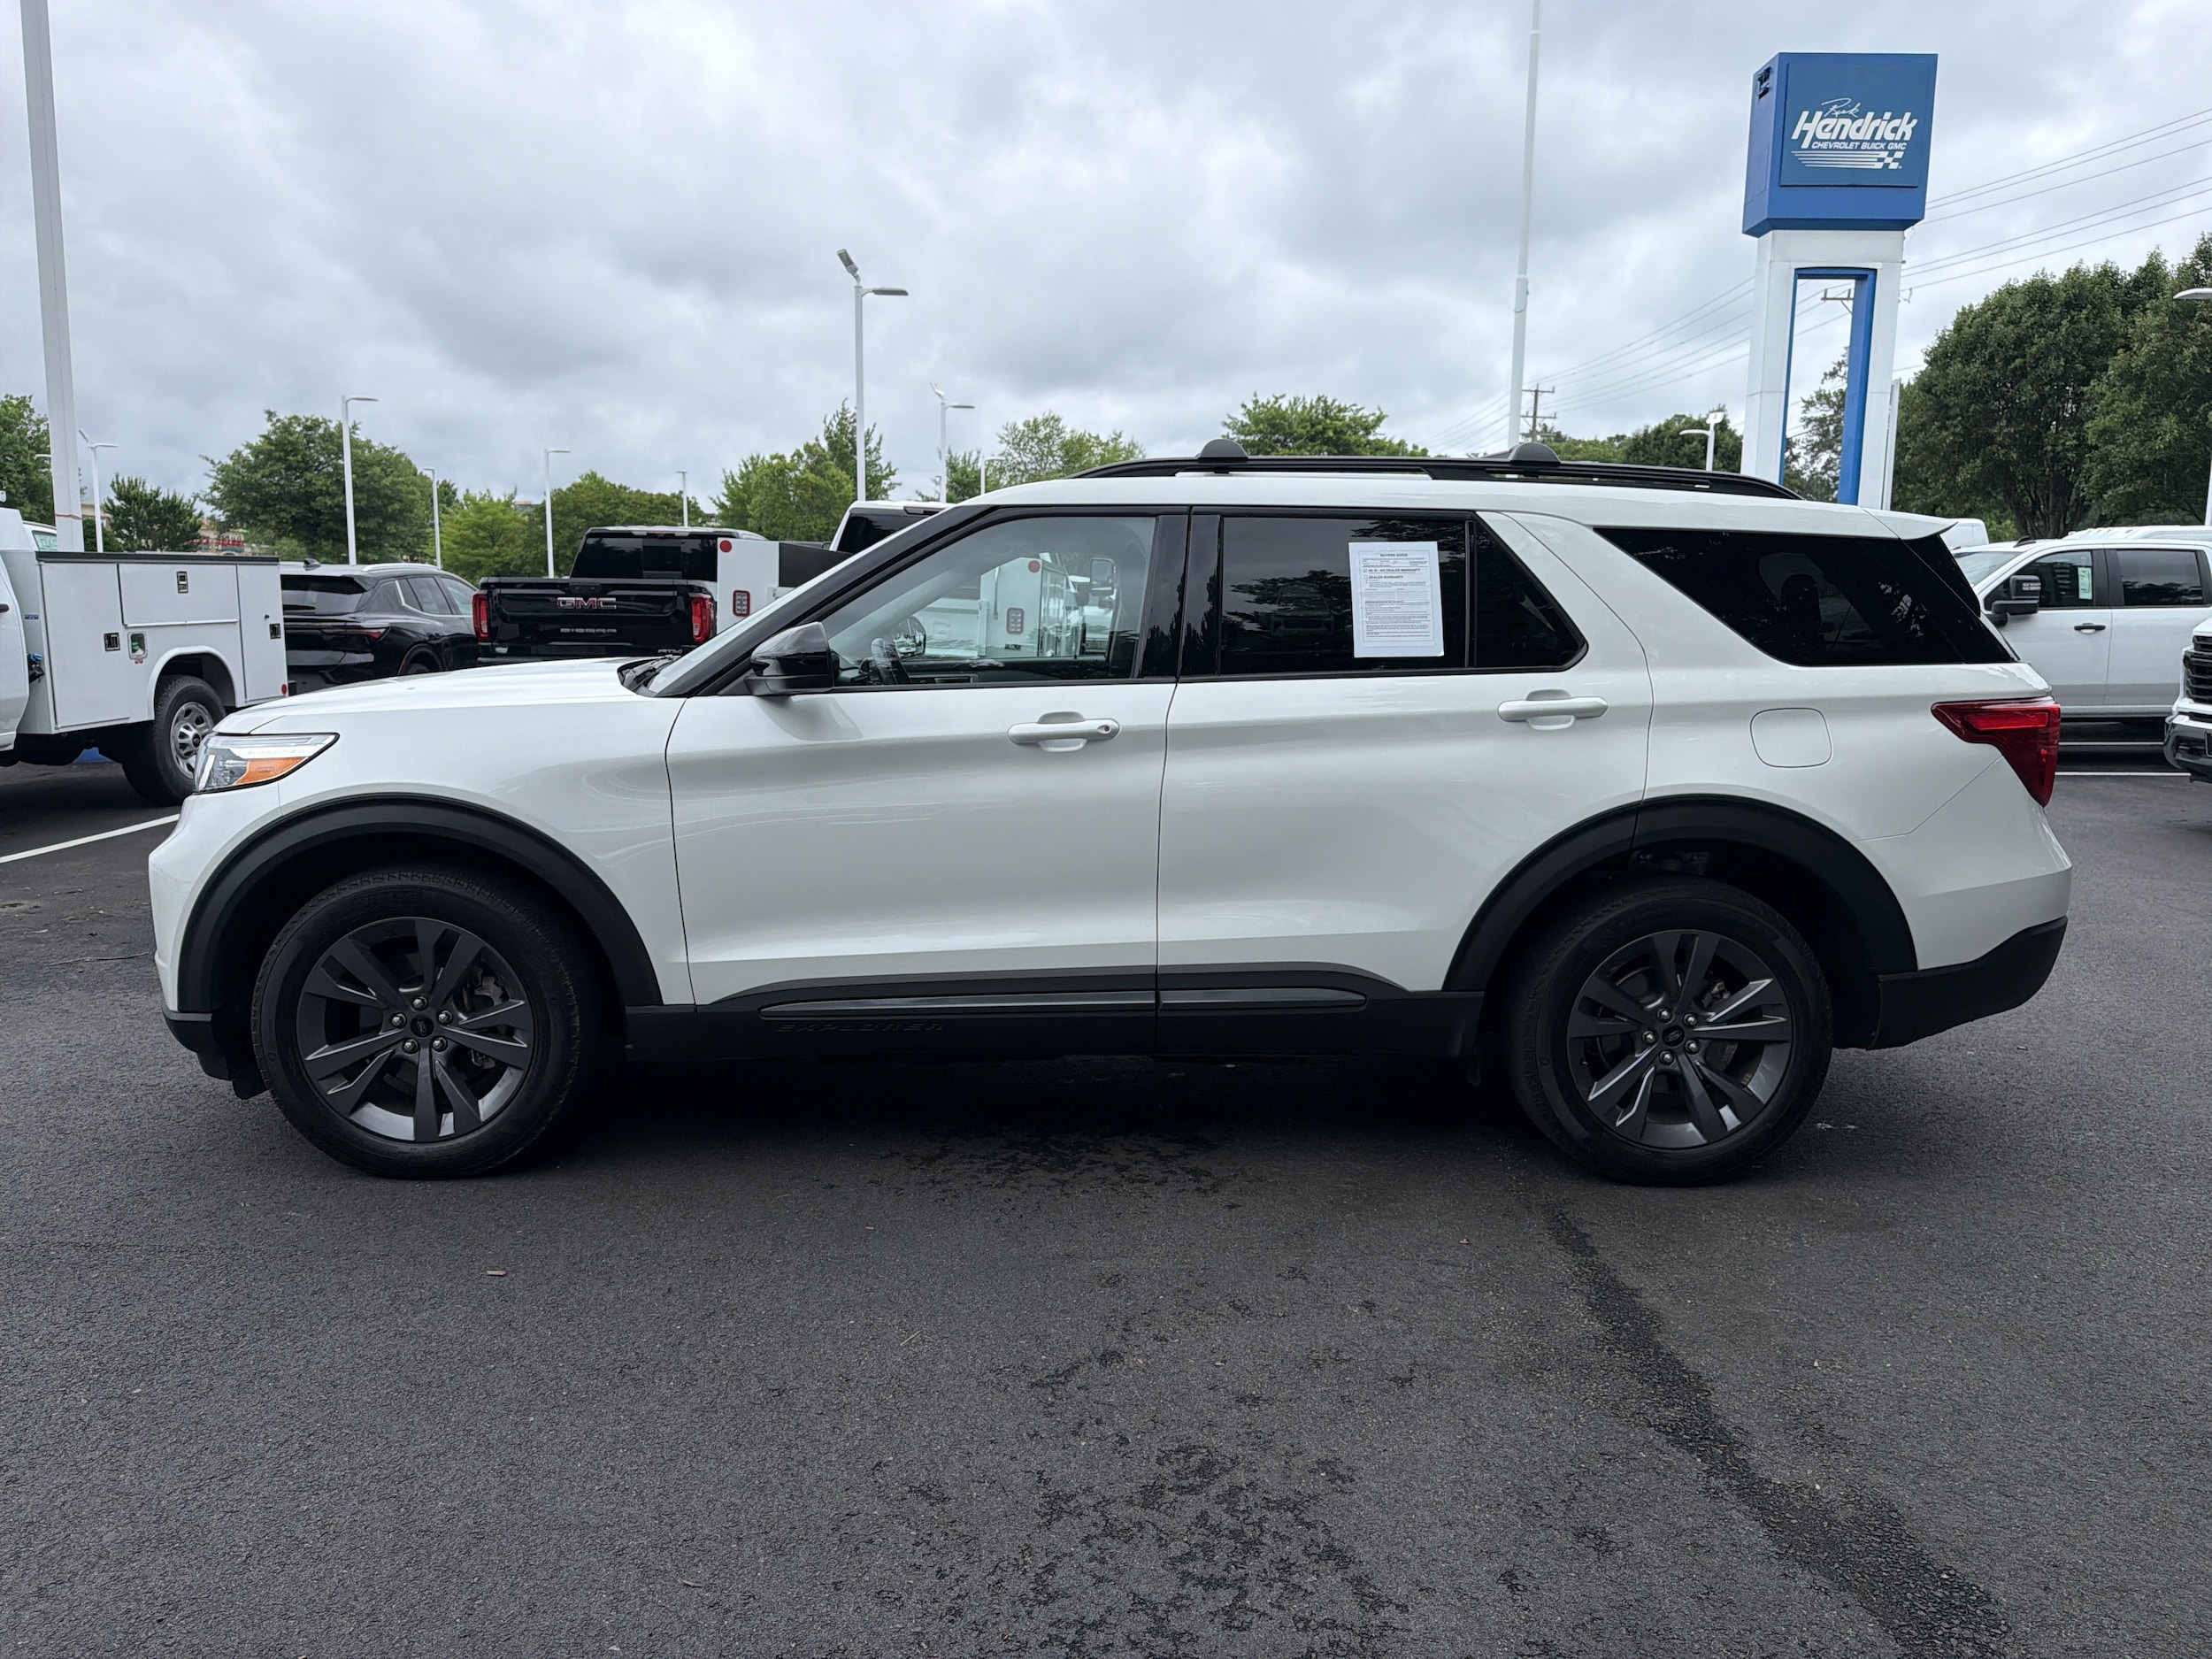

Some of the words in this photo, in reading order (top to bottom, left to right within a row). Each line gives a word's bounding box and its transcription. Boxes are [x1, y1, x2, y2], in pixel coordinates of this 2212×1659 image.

[1791, 111, 1918, 149] Hendrick
[1811, 141, 1860, 150] CHEVROLET
[1861, 142, 1886, 150] BUICK
[557, 597, 617, 610] GMC
